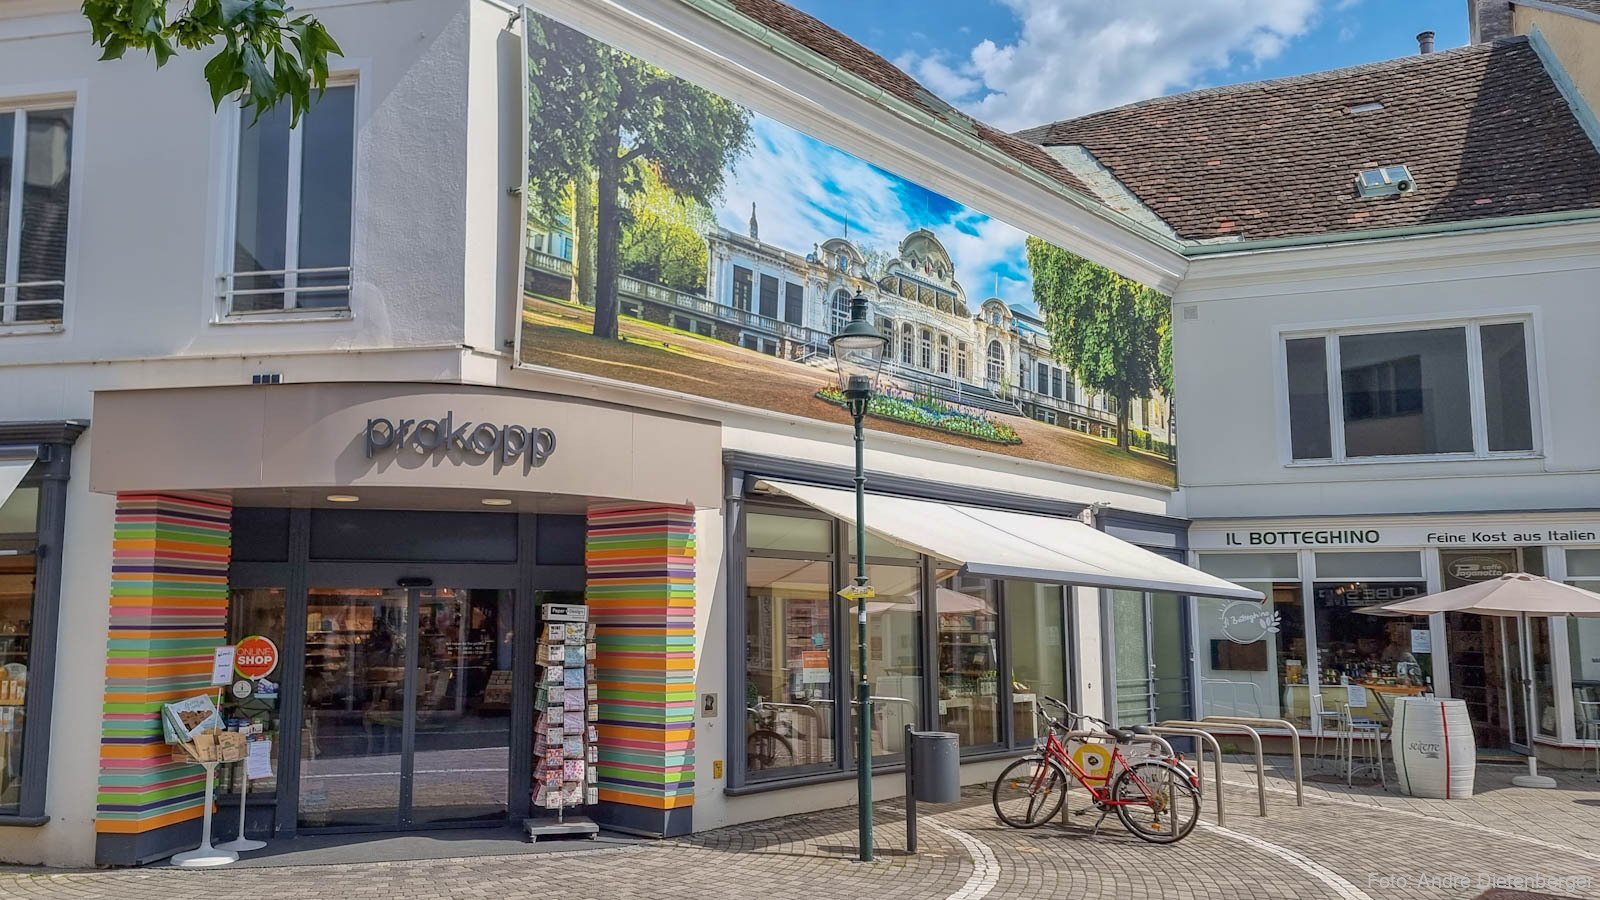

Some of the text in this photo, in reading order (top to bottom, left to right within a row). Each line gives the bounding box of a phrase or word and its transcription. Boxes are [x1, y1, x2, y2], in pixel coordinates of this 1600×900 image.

[367, 411, 556, 463] prokopp
[1226, 530, 1380, 545] IL BOTTEGHINO
[1427, 530, 1596, 543] Feine Kost aus Italien
[238, 656, 272, 665] SHOP
